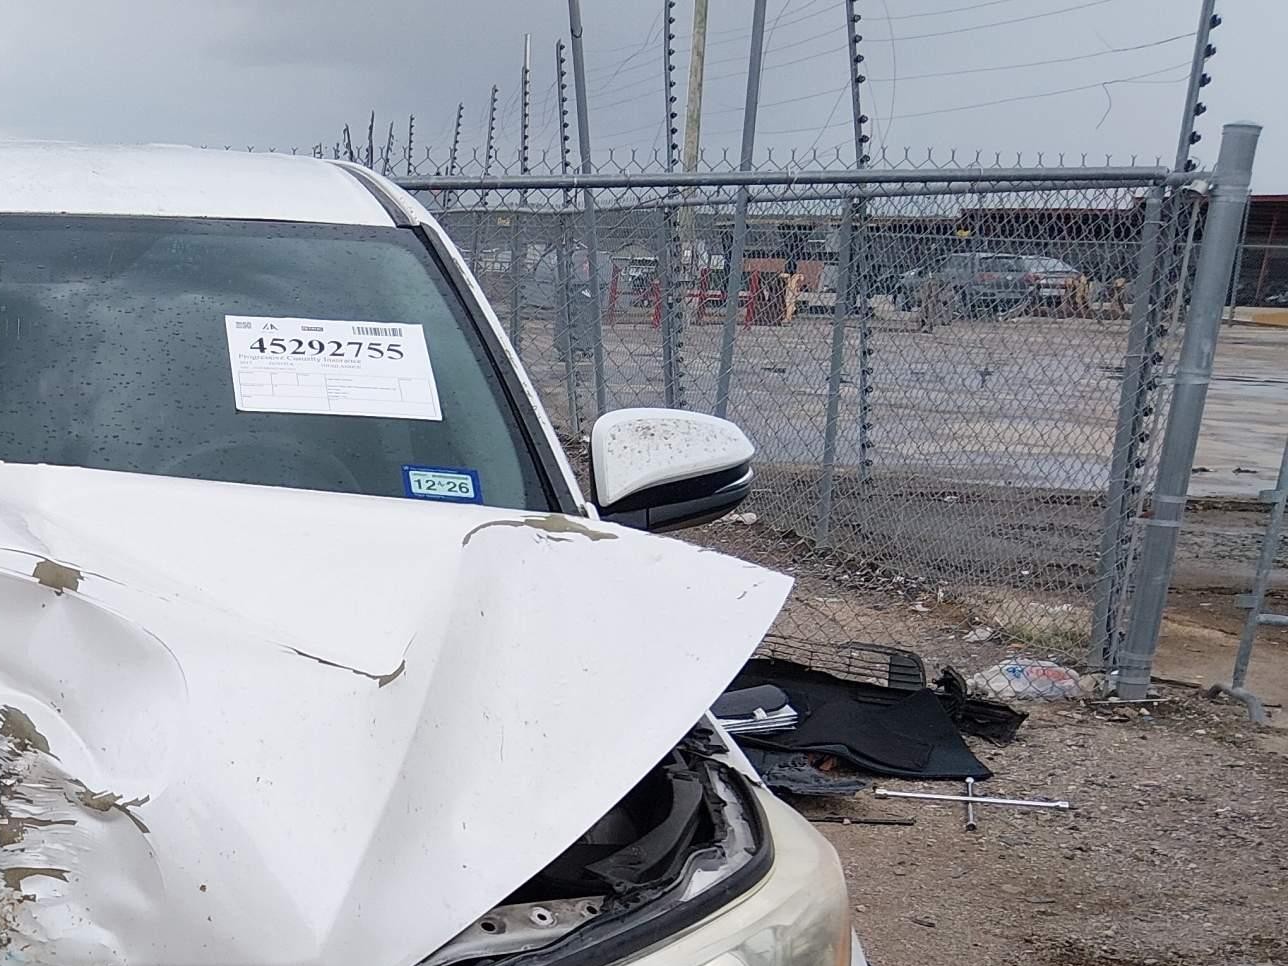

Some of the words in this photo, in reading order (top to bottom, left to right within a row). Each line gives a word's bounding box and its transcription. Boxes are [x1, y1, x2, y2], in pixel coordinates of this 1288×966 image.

[249, 336, 404, 360] 45292755
[413, 478, 437, 491] 12
[446, 481, 470, 494] 26
